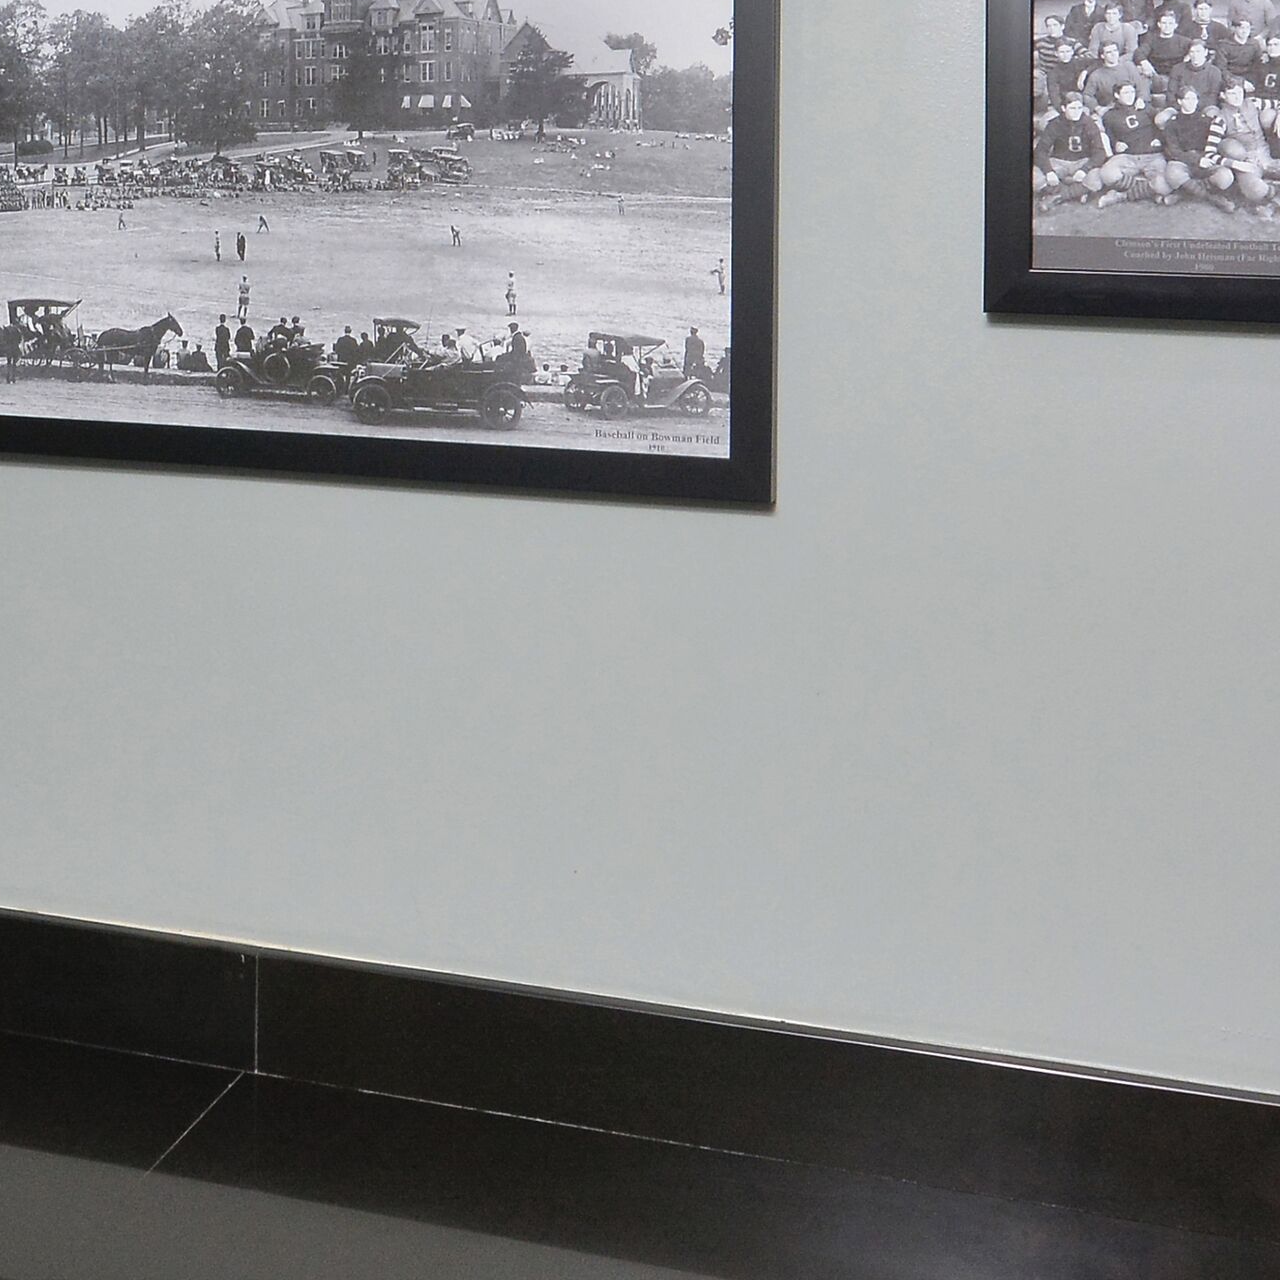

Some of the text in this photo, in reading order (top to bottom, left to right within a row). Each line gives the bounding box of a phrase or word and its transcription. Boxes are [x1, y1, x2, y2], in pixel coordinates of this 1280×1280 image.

[1182, 240, 1231, 251] Undefeated
[1233, 241, 1269, 251] Football
[1124, 250, 1160, 259] Coached
[1162, 251, 1173, 261] by
[1174, 252, 1196, 261] John
[1197, 253, 1236, 263] Heisman
[594, 429, 721, 445] Baseball on Bowman Field
